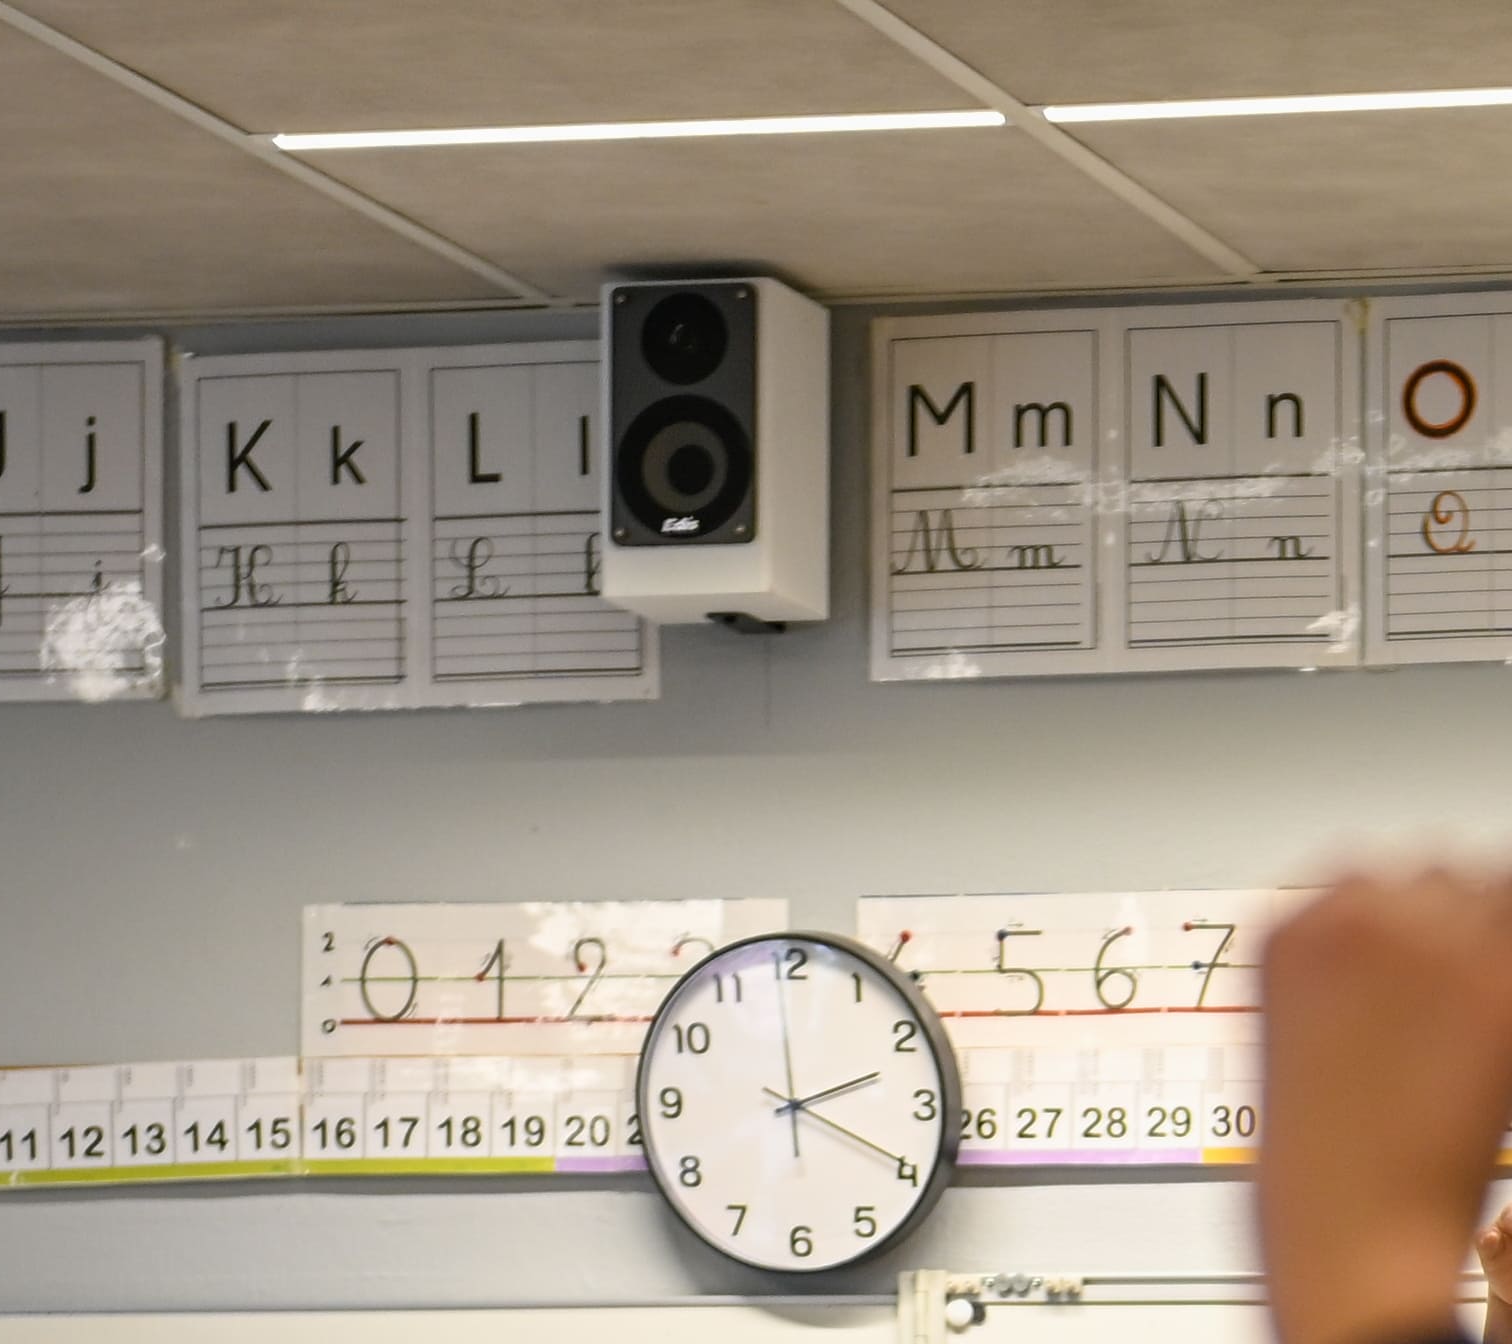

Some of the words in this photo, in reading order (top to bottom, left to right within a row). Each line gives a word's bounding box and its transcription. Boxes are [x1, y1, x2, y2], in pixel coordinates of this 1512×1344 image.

[1153, 372, 1208, 448] N
[1266, 392, 1304, 439] n
[1401, 359, 1478, 440] O
[907, 381, 976, 458] M
[1013, 401, 1073, 449] m
[78, 415, 97, 494] j
[226, 419, 272, 494] K
[331, 425, 366, 486] k
[468, 411, 502, 485] L
[579, 415, 590, 476] l
[361, 936, 418, 1023] 0
[479, 937, 507, 1022] 1
[564, 936, 607, 1023] 2
[997, 928, 1045, 1016] 5
[1094, 926, 1138, 1010] 6
[1183, 922, 1236, 1010] 7
[772, 948, 809, 981] 12
[713, 971, 742, 1003] 11
[850, 971, 863, 1003] 1
[672, 1022, 711, 1054] 10
[893, 1019, 917, 1053] 2
[659, 1086, 683, 1119] 9
[913, 1088, 937, 1121] 3
[60, 1125, 105, 1159] 12
[122, 1122, 167, 1156] 13
[184, 1120, 229, 1153] 14
[247, 1117, 292, 1150] 15
[312, 1117, 356, 1149] 16
[374, 1116, 420, 1148] 17
[438, 1115, 483, 1148] 18
[501, 1115, 546, 1148] 19
[565, 1115, 611, 1148] 20
[955, 1107, 997, 1145] 26
[1016, 1107, 1064, 1139] 27
[1082, 1106, 1128, 1139] 28
[1147, 1106, 1193, 1138] 29
[1212, 1099, 1260, 1139] 30
[679, 1155, 702, 1188] 8
[897, 1156, 919, 1187] 4
[726, 1204, 747, 1237] 7
[854, 1206, 877, 1238] 5
[790, 1225, 813, 1258] 6
